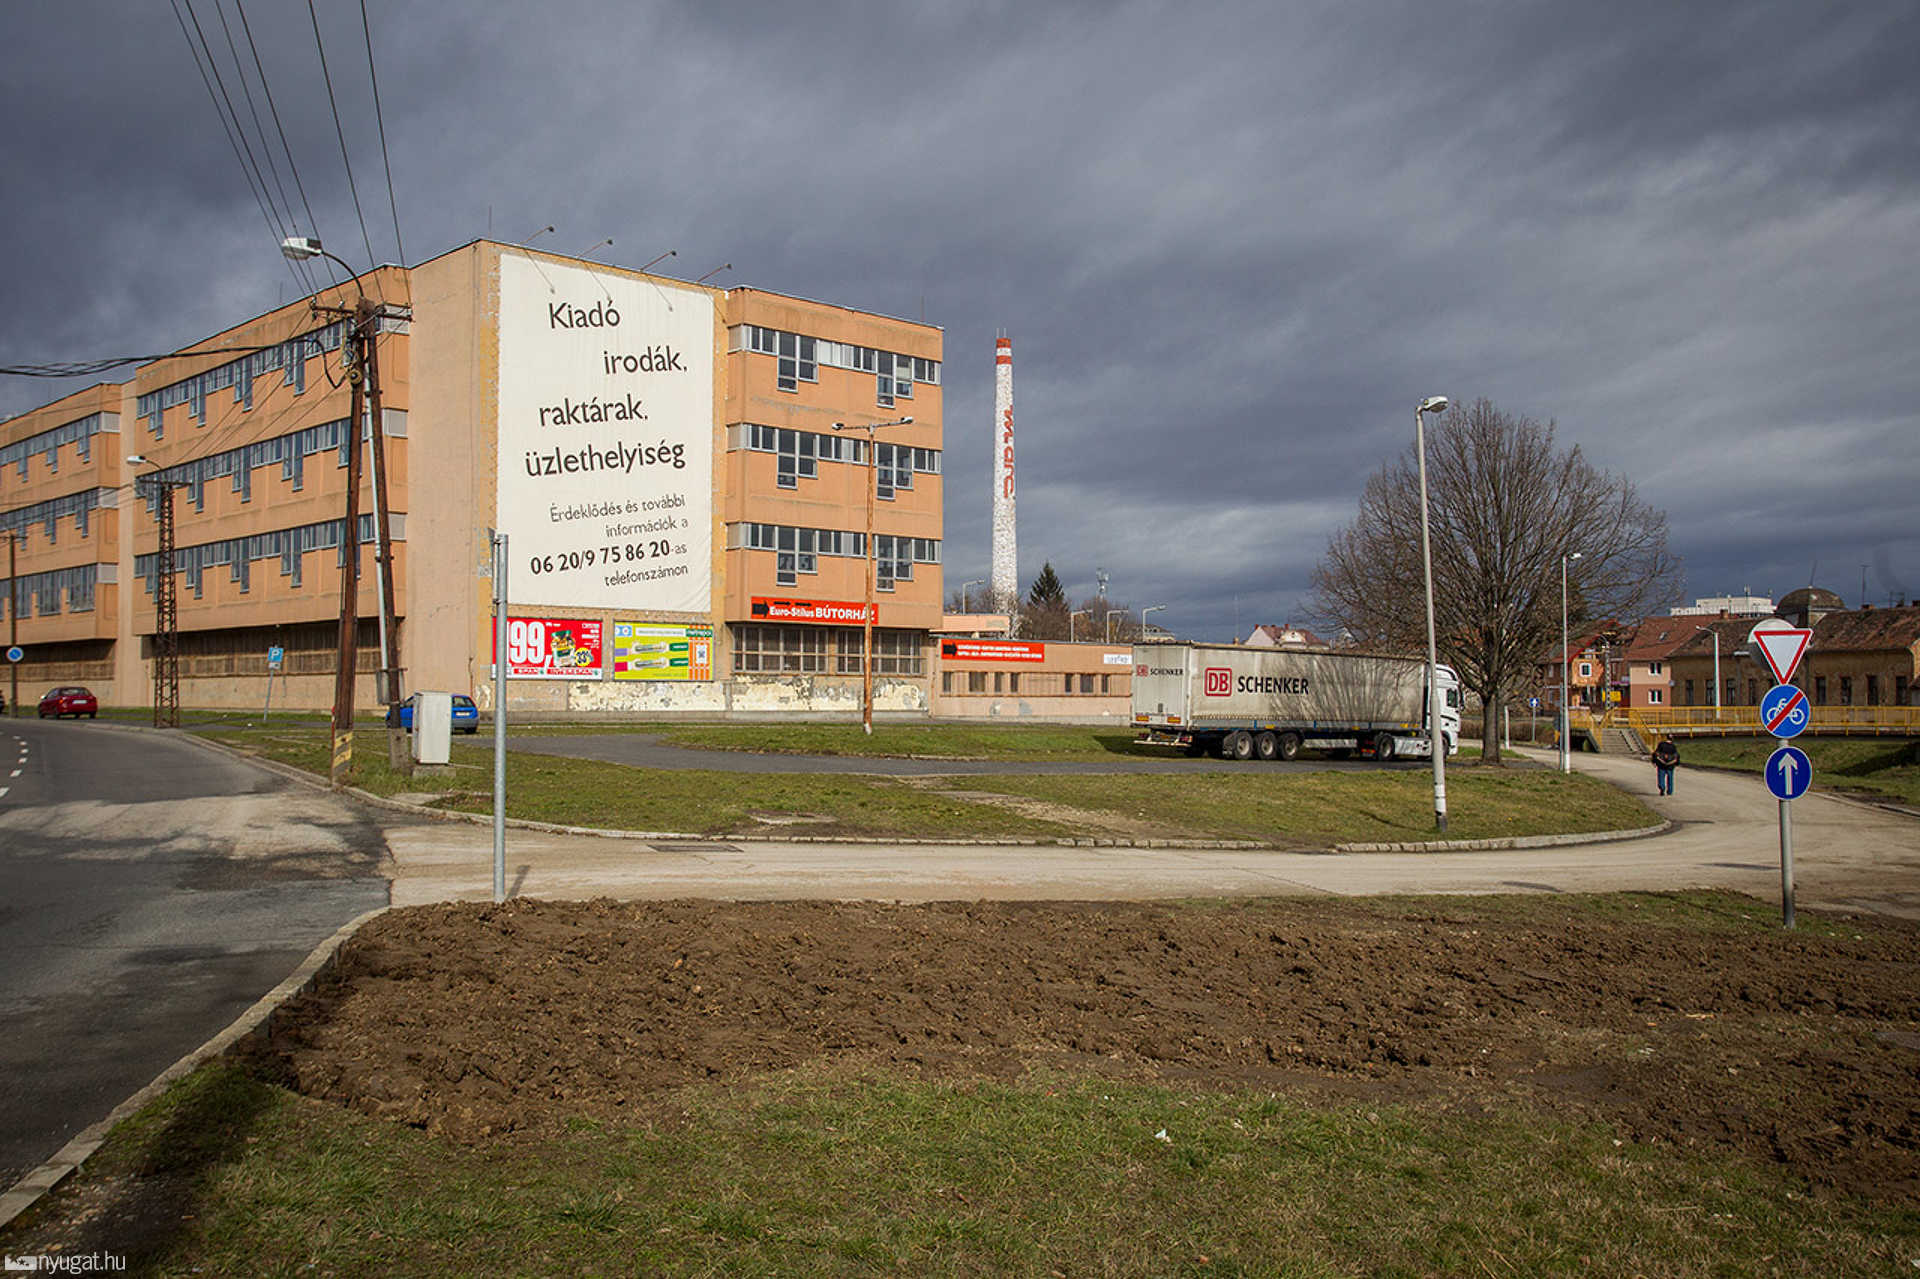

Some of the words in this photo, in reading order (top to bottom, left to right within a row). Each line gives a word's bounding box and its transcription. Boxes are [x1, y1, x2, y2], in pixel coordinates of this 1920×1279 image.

[549, 300, 621, 329] Kiadó
[525, 439, 686, 477] üzlethelyiség
[550, 502, 622, 523] Érdeklődés
[625, 499, 639, 514] és
[641, 493, 686, 512] további
[605, 515, 678, 538] információk
[681, 518, 688, 529] a
[530, 556, 553, 575] 06
[558, 549, 595, 572] 20/9
[600, 546, 621, 564] 75
[625, 543, 645, 561] 86
[604, 564, 688, 587] telefonszámon
[1150, 667, 1184, 676] SCHENKER
[1207, 670, 1230, 693] DB
[1238, 675, 1310, 696] SCHENKER
